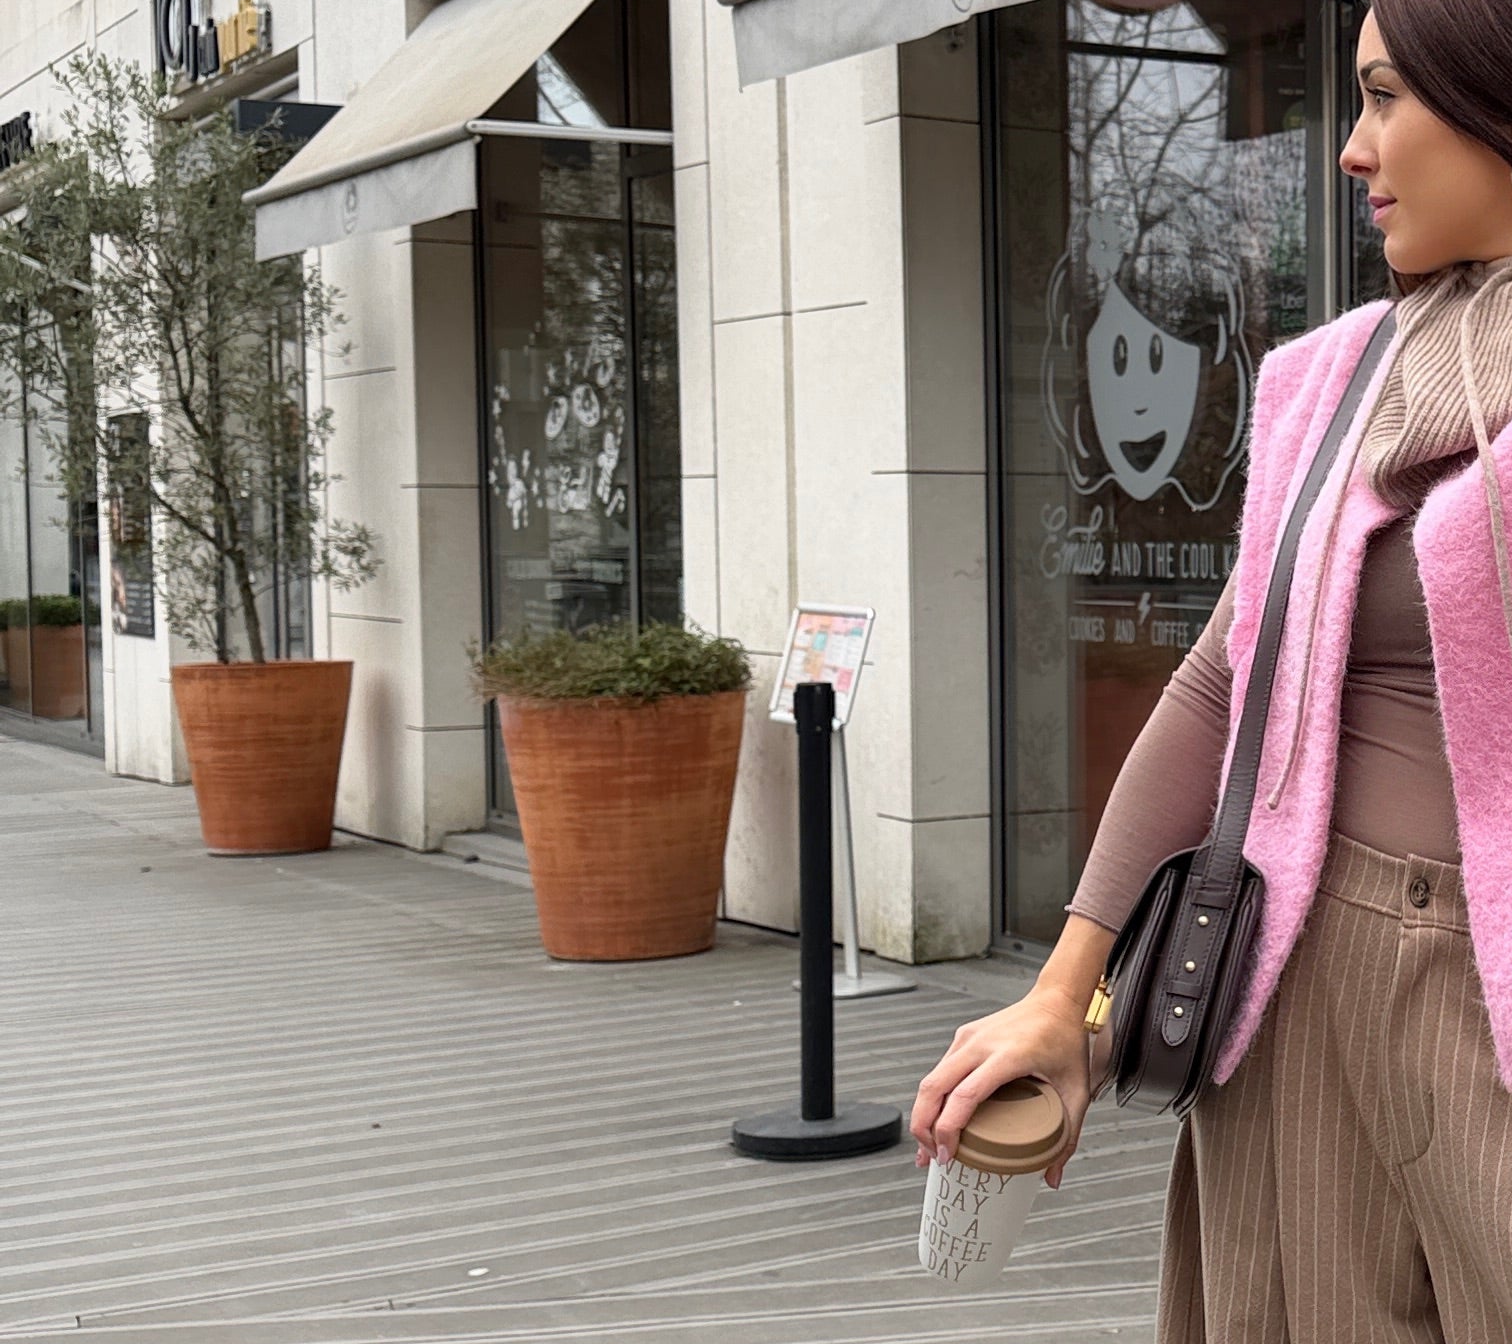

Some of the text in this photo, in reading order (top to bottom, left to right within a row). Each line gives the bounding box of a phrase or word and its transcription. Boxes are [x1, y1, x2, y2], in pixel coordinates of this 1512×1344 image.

[1040, 504, 1106, 579] Emilie
[1110, 542, 1142, 577] AND
[1145, 542, 1175, 579] THE
[1180, 543, 1219, 580] COOL
[1114, 618, 1136, 644] AND
[1151, 620, 1190, 649] COFFEE
[938, 1159, 1014, 1194] VERY
[939, 1174, 990, 1215] DAY
[923, 1213, 993, 1263] COFFEE
[932, 1198, 979, 1239] IS A
[927, 1246, 968, 1283] DAY
